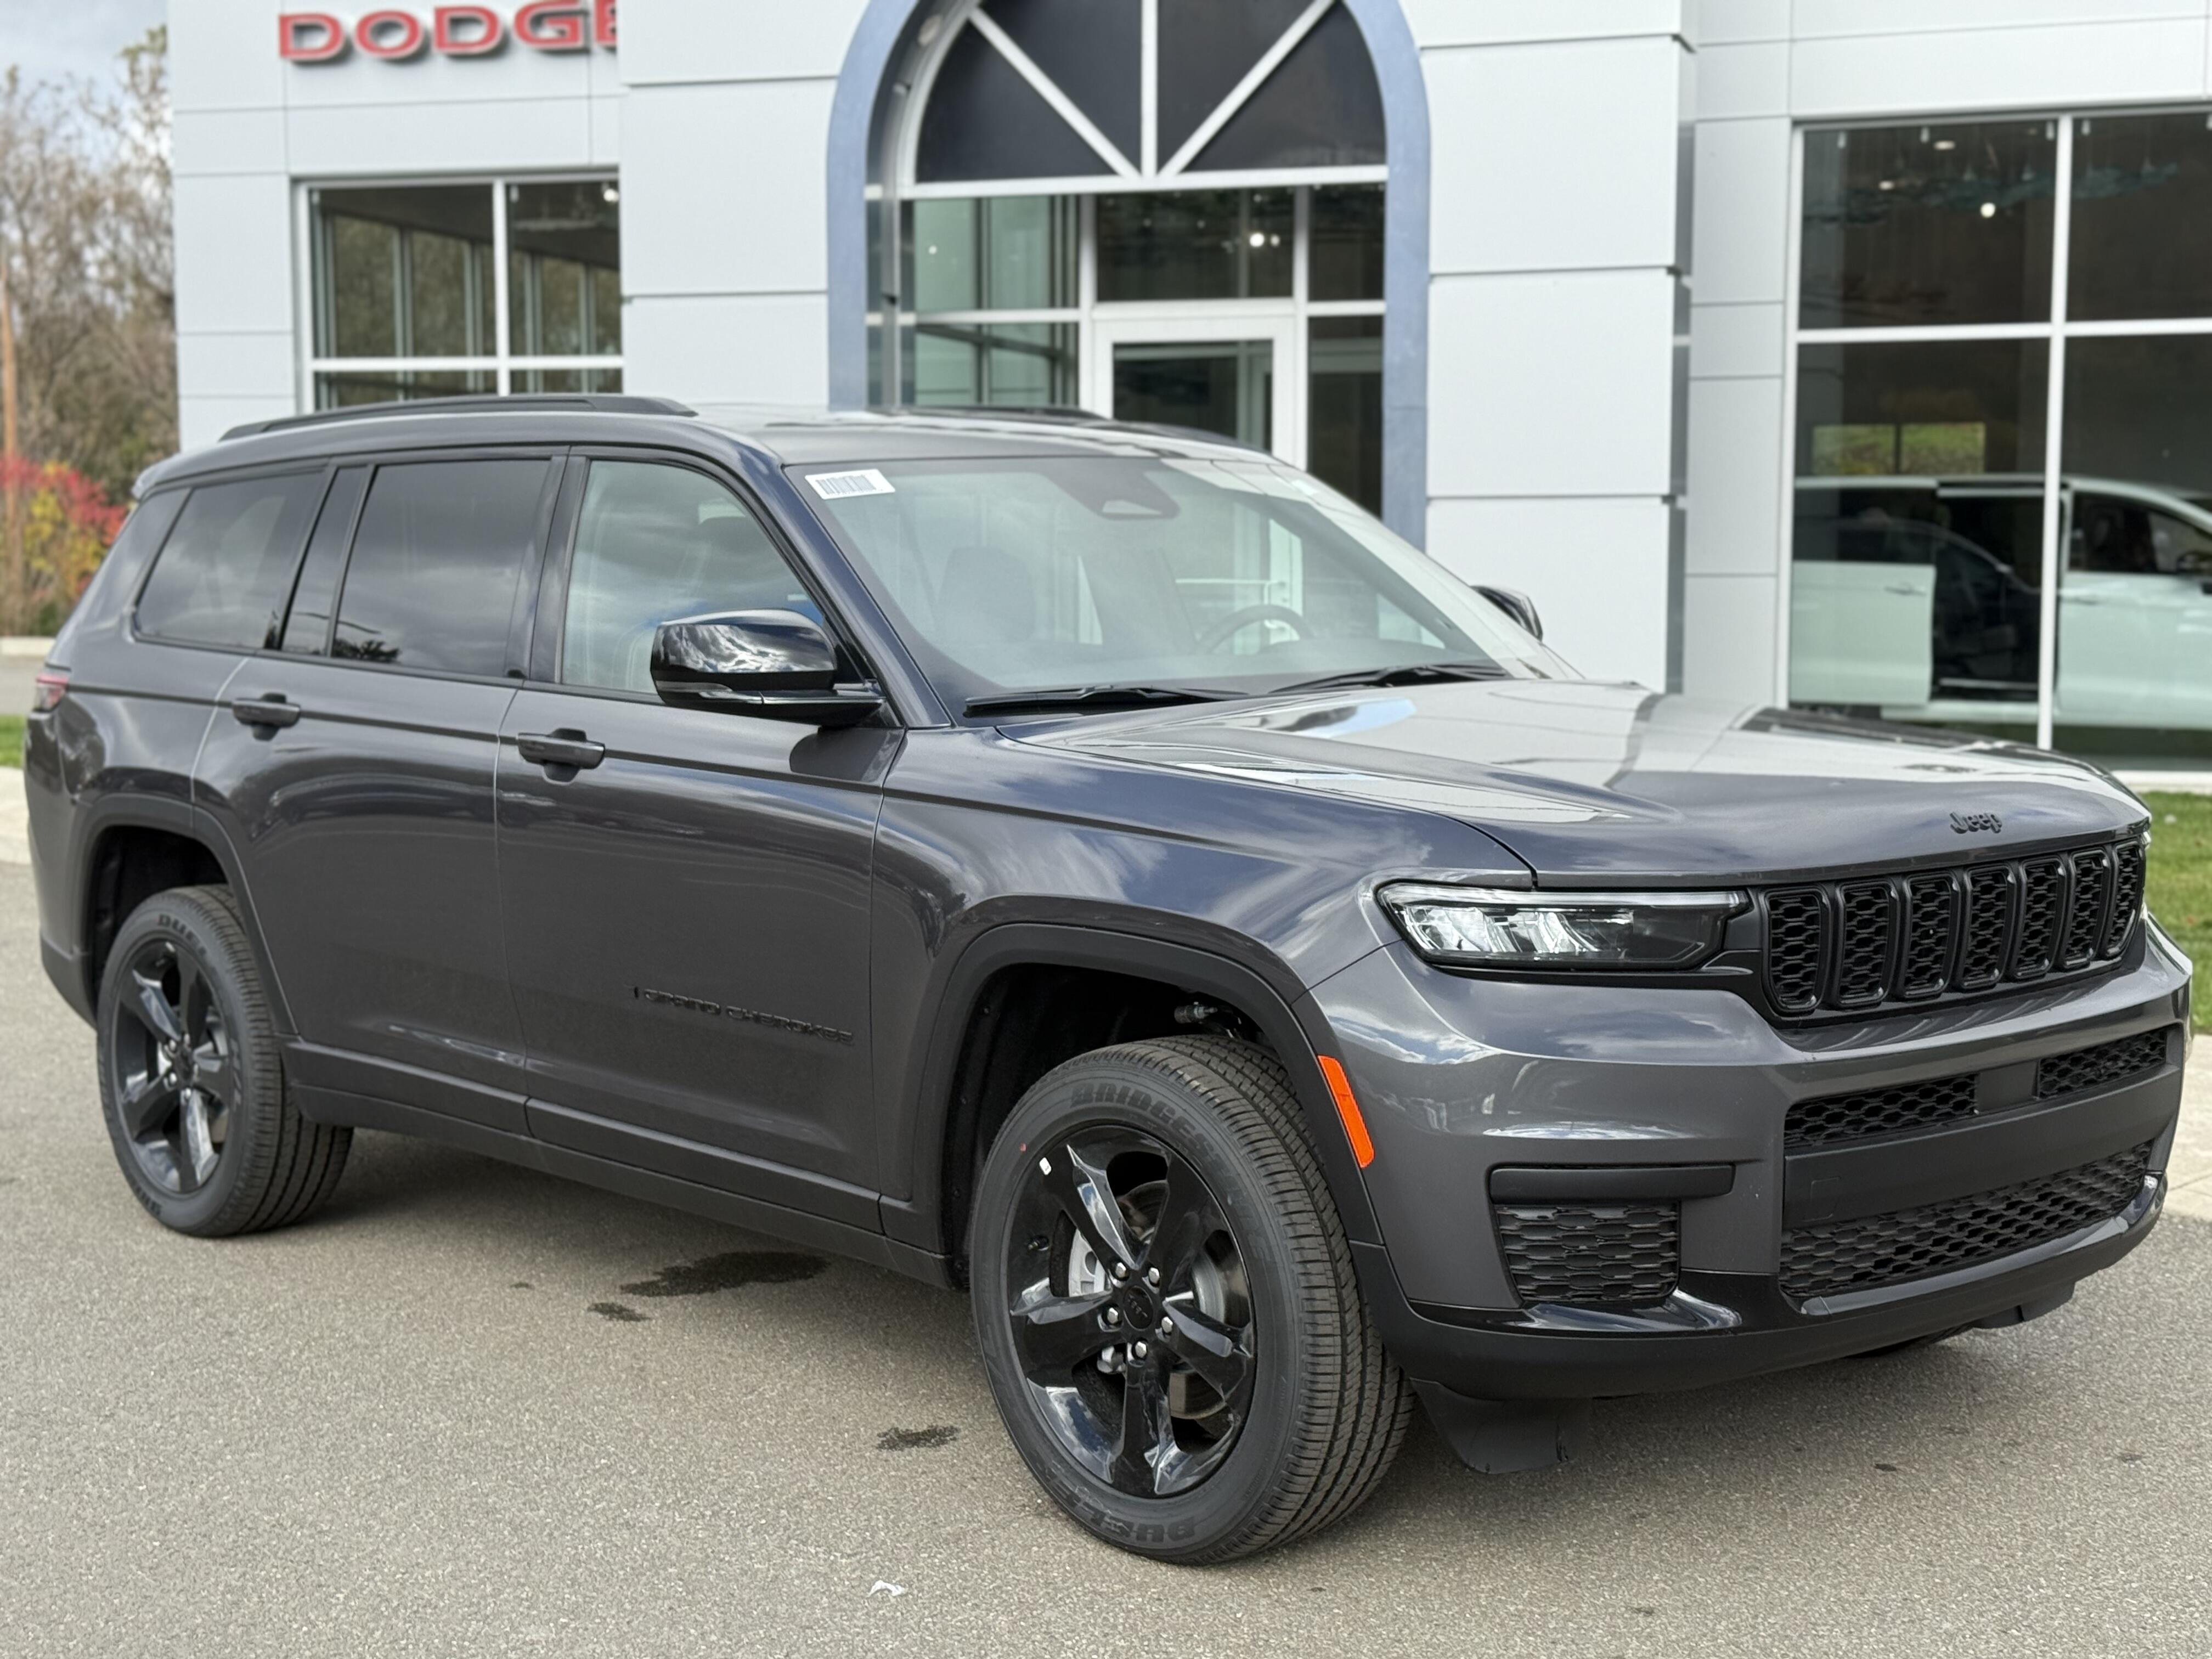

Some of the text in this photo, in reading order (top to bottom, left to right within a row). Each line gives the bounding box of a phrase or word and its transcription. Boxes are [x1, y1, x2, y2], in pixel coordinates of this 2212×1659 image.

[1949, 811, 2003, 834] Jeep
[644, 989, 855, 1046] GRAND CHEROKEE
